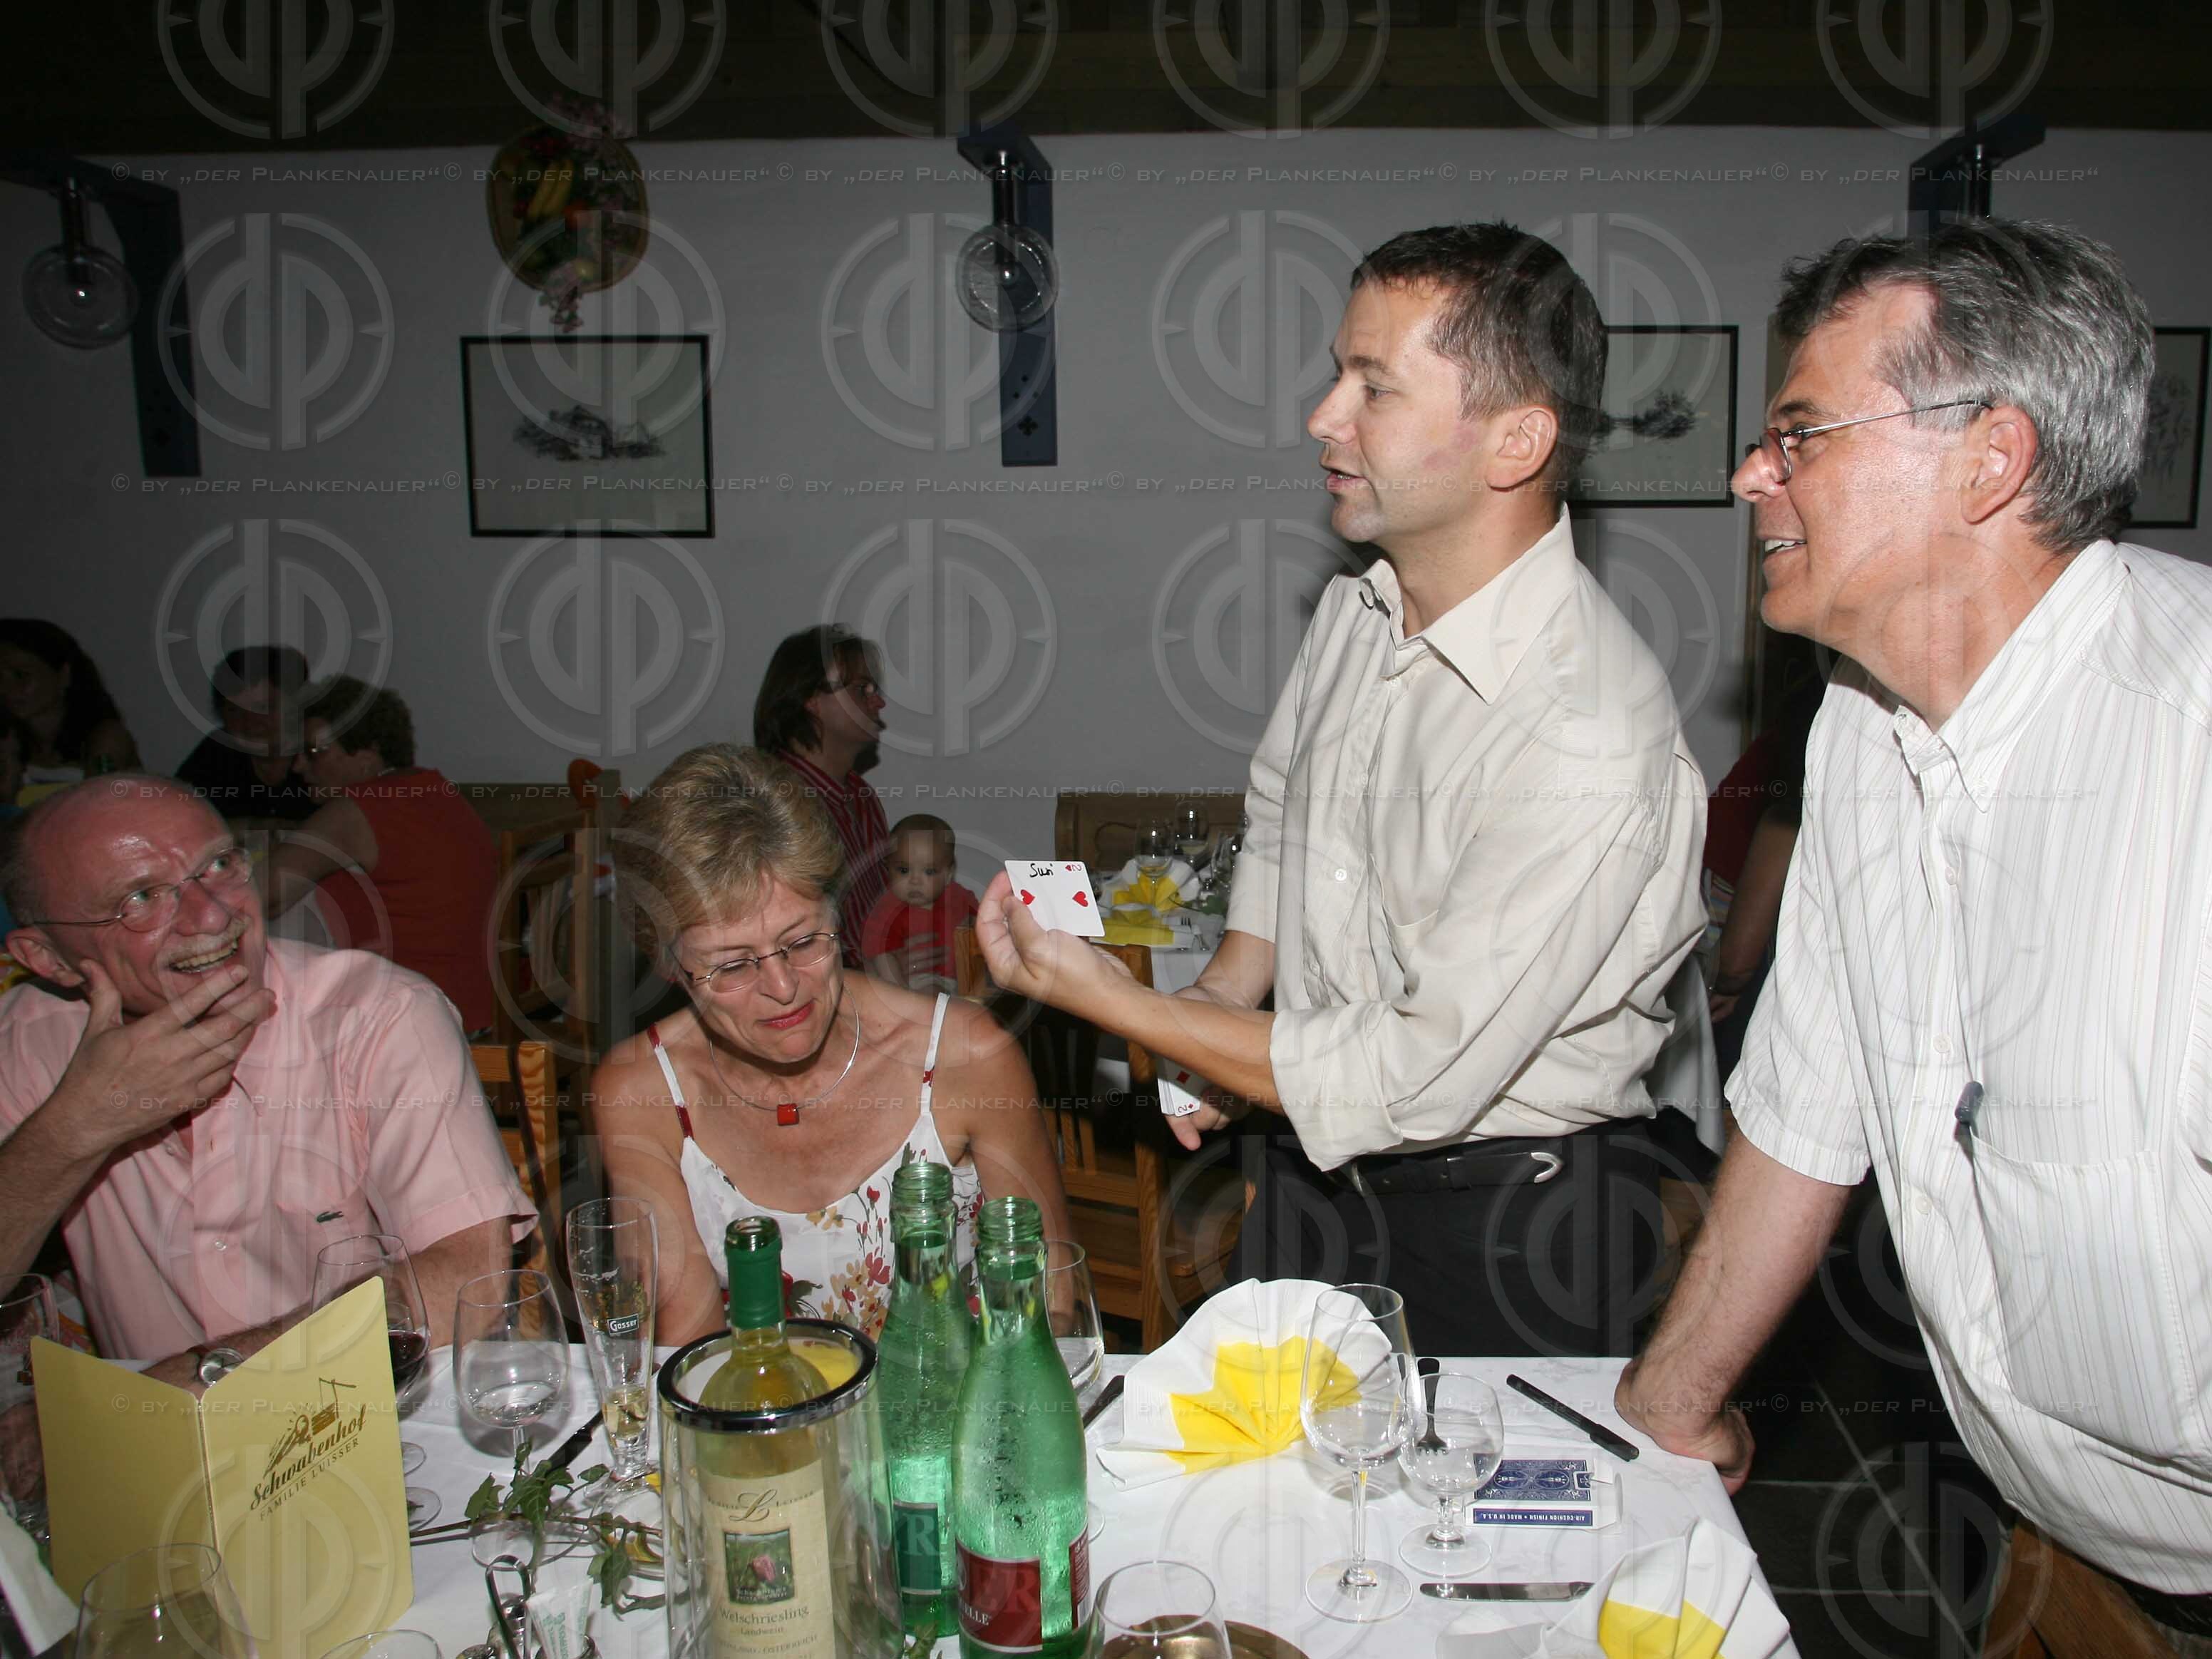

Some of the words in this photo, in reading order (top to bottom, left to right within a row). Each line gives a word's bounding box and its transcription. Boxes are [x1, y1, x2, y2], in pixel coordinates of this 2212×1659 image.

[259, 1476, 307, 1521] FAMILIE
[312, 1438, 359, 1479] LUISSER
[719, 1606, 810, 1625] Welschriesling
